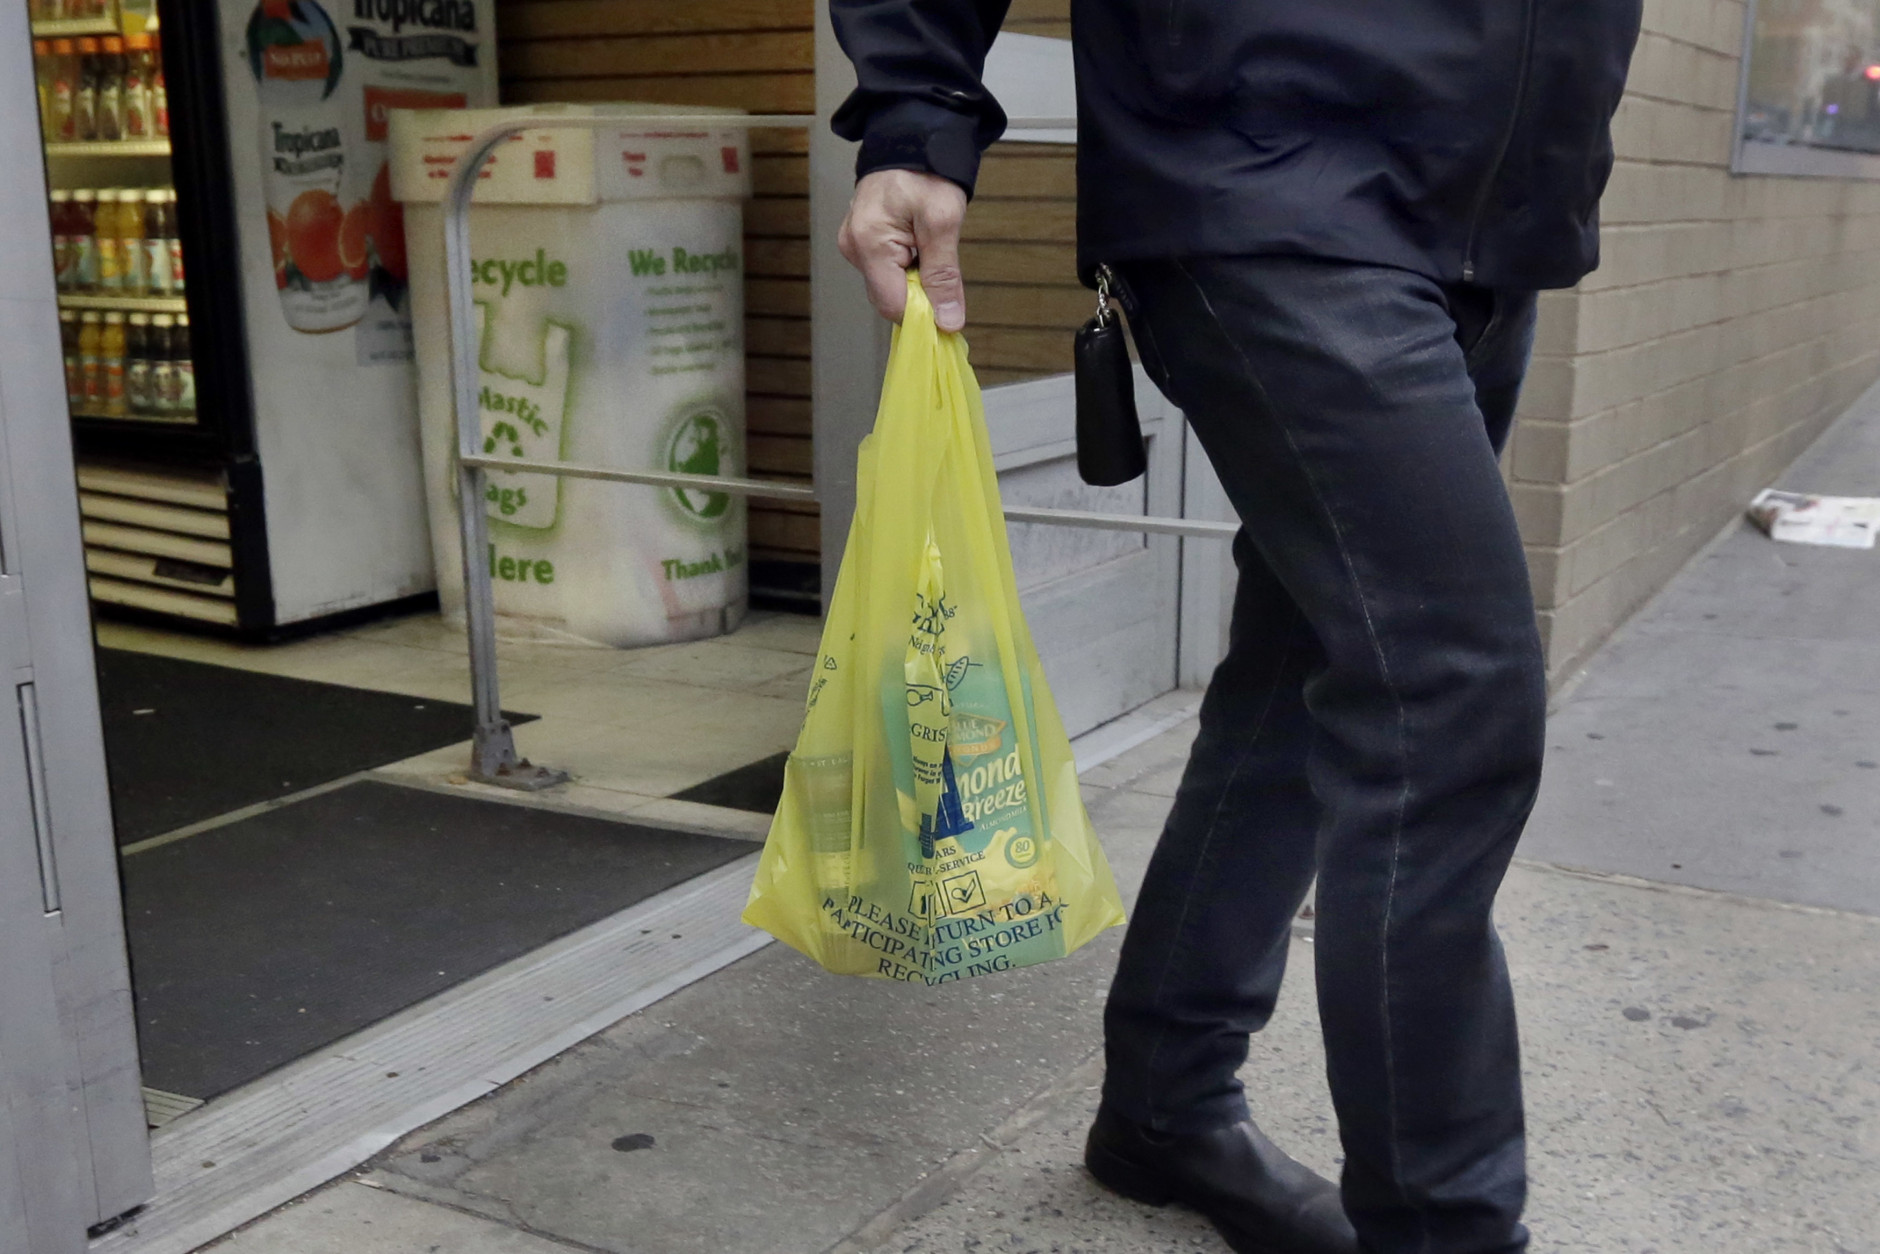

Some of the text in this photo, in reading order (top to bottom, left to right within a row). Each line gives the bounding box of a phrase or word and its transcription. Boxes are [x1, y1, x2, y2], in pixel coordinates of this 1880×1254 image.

[471, 249, 567, 297] ecycle
[485, 483, 527, 516] ags
[956, 743, 1022, 799] mond
[935, 845, 957, 860] ARS
[1015, 840, 1031, 853] 80
[848, 895, 921, 941] PLEASE
[929, 910, 996, 945] TURN
[999, 897, 1032, 922] TO
[1039, 891, 1053, 909] A
[967, 918, 1043, 958] STORE
